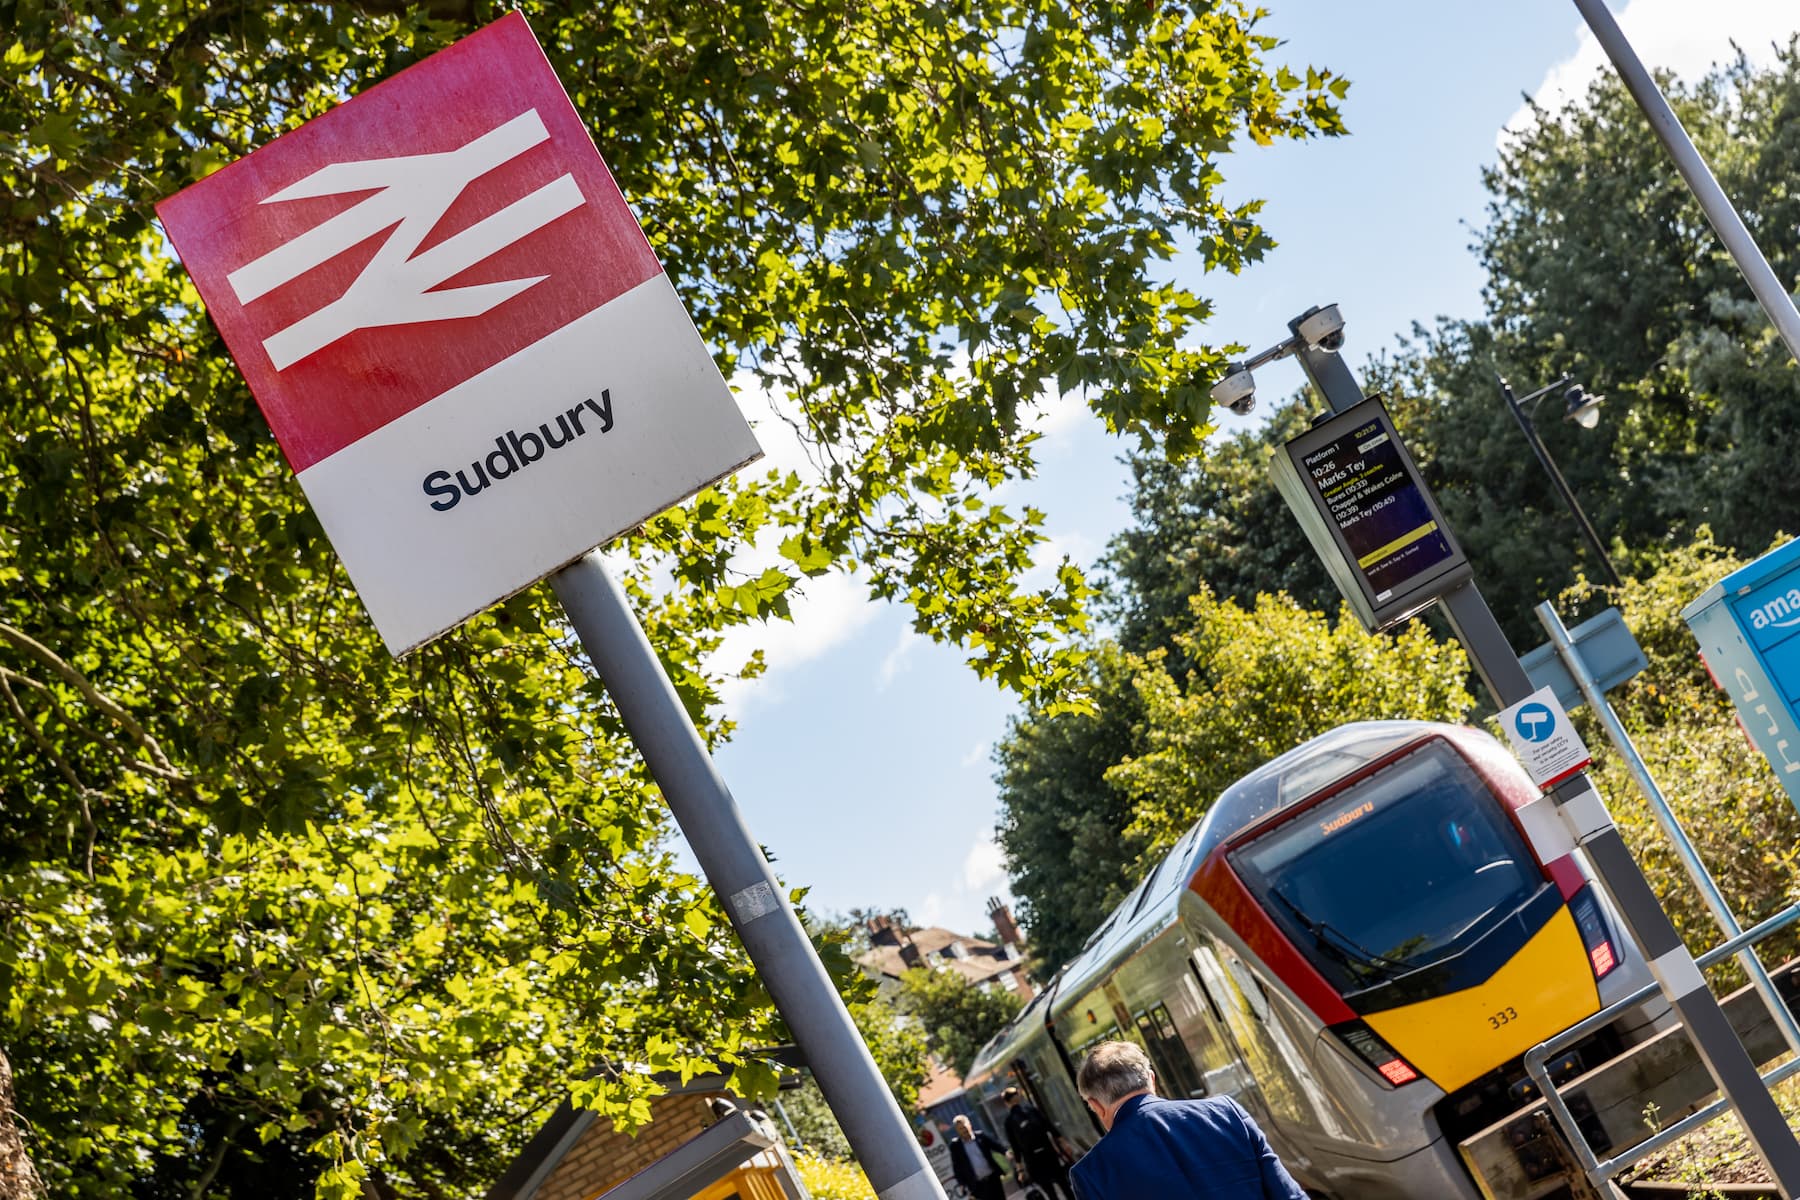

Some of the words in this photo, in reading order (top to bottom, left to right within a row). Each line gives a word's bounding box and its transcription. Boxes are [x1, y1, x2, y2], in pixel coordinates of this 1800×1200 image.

[423, 388, 614, 511] Sudbury
[1305, 448, 1335, 466] Platform
[1312, 461, 1335, 478] 10:26
[1318, 471, 1346, 489] Marks
[1345, 460, 1365, 473] Tey
[1327, 492, 1346, 505] Bures
[1345, 479, 1367, 495] (10:33)
[1331, 495, 1357, 512] Chappel
[1363, 482, 1384, 495] Wakes
[1384, 472, 1403, 484] Colne
[1336, 505, 1358, 520] (10:39)
[1340, 516, 1359, 529] Marks
[1359, 508, 1372, 518] Tey
[1372, 496, 1395, 511] (10:45)
[1750, 589, 1800, 629] ama
[1488, 1007, 1517, 1029] 333
